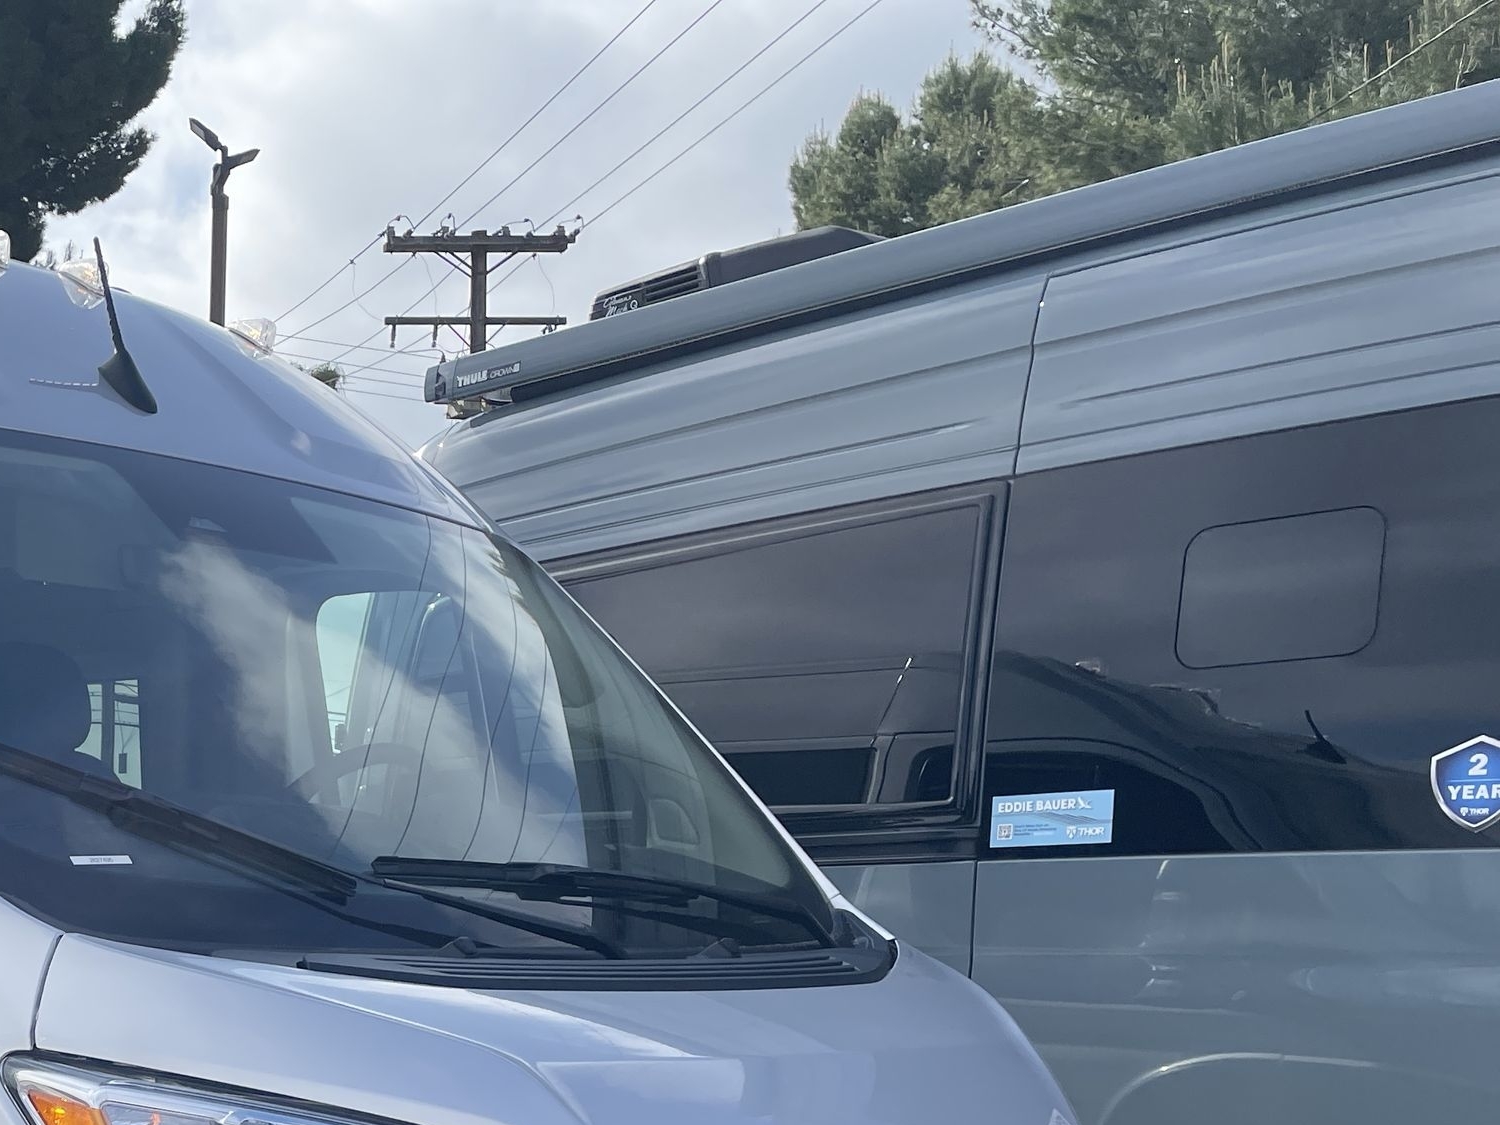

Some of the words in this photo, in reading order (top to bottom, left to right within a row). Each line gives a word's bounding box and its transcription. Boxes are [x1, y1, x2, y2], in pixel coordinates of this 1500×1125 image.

[457, 370, 488, 387] THULE
[1468, 753, 1489, 776] 2
[1447, 784, 1500, 800] YEAR
[998, 801, 1033, 813] EDDIE
[1036, 799, 1077, 811] BAUER
[1078, 827, 1105, 836] THOR
